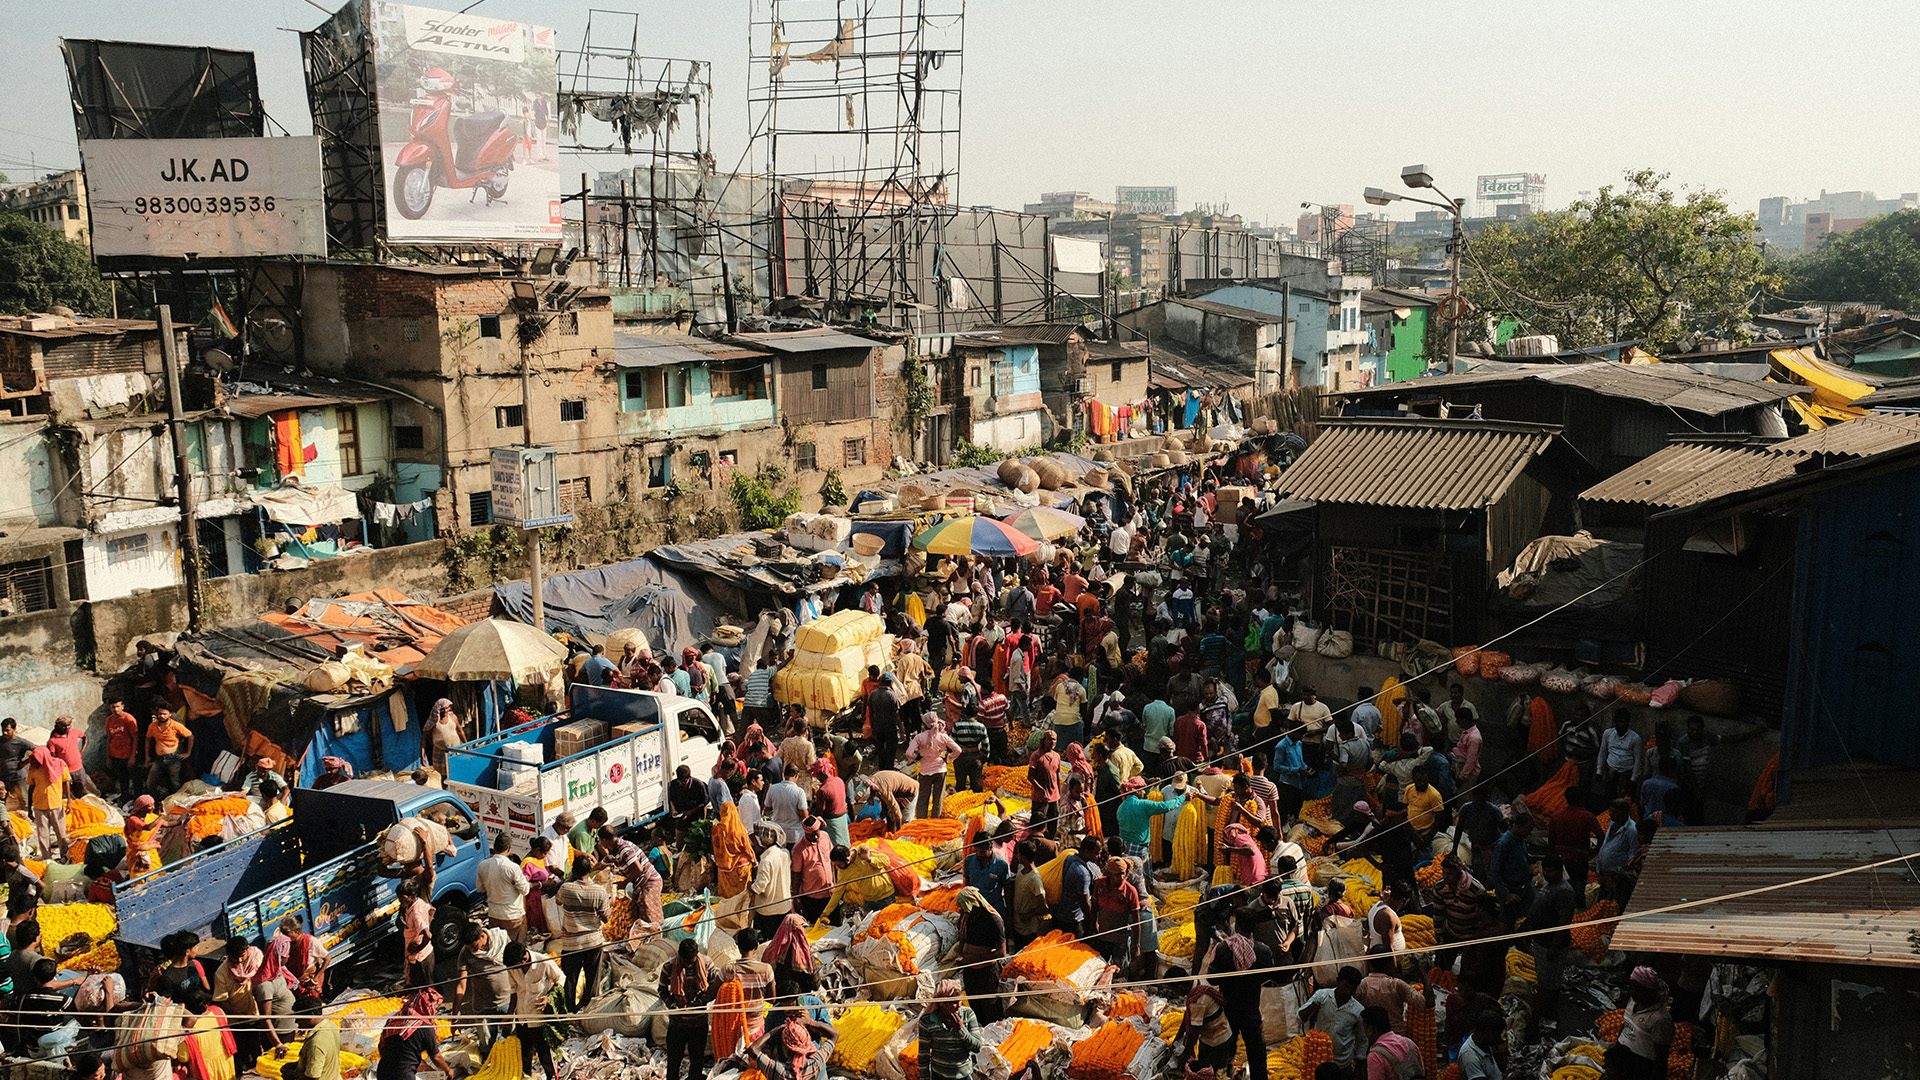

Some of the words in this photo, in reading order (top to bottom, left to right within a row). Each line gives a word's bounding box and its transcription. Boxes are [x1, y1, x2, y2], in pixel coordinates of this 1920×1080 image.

[420, 19, 485, 38] Scooter
[414, 35, 511, 54] ACTIVA
[161, 158, 206, 182] J.K.
[210, 158, 249, 182] AD
[1481, 180, 1521, 192] विमल
